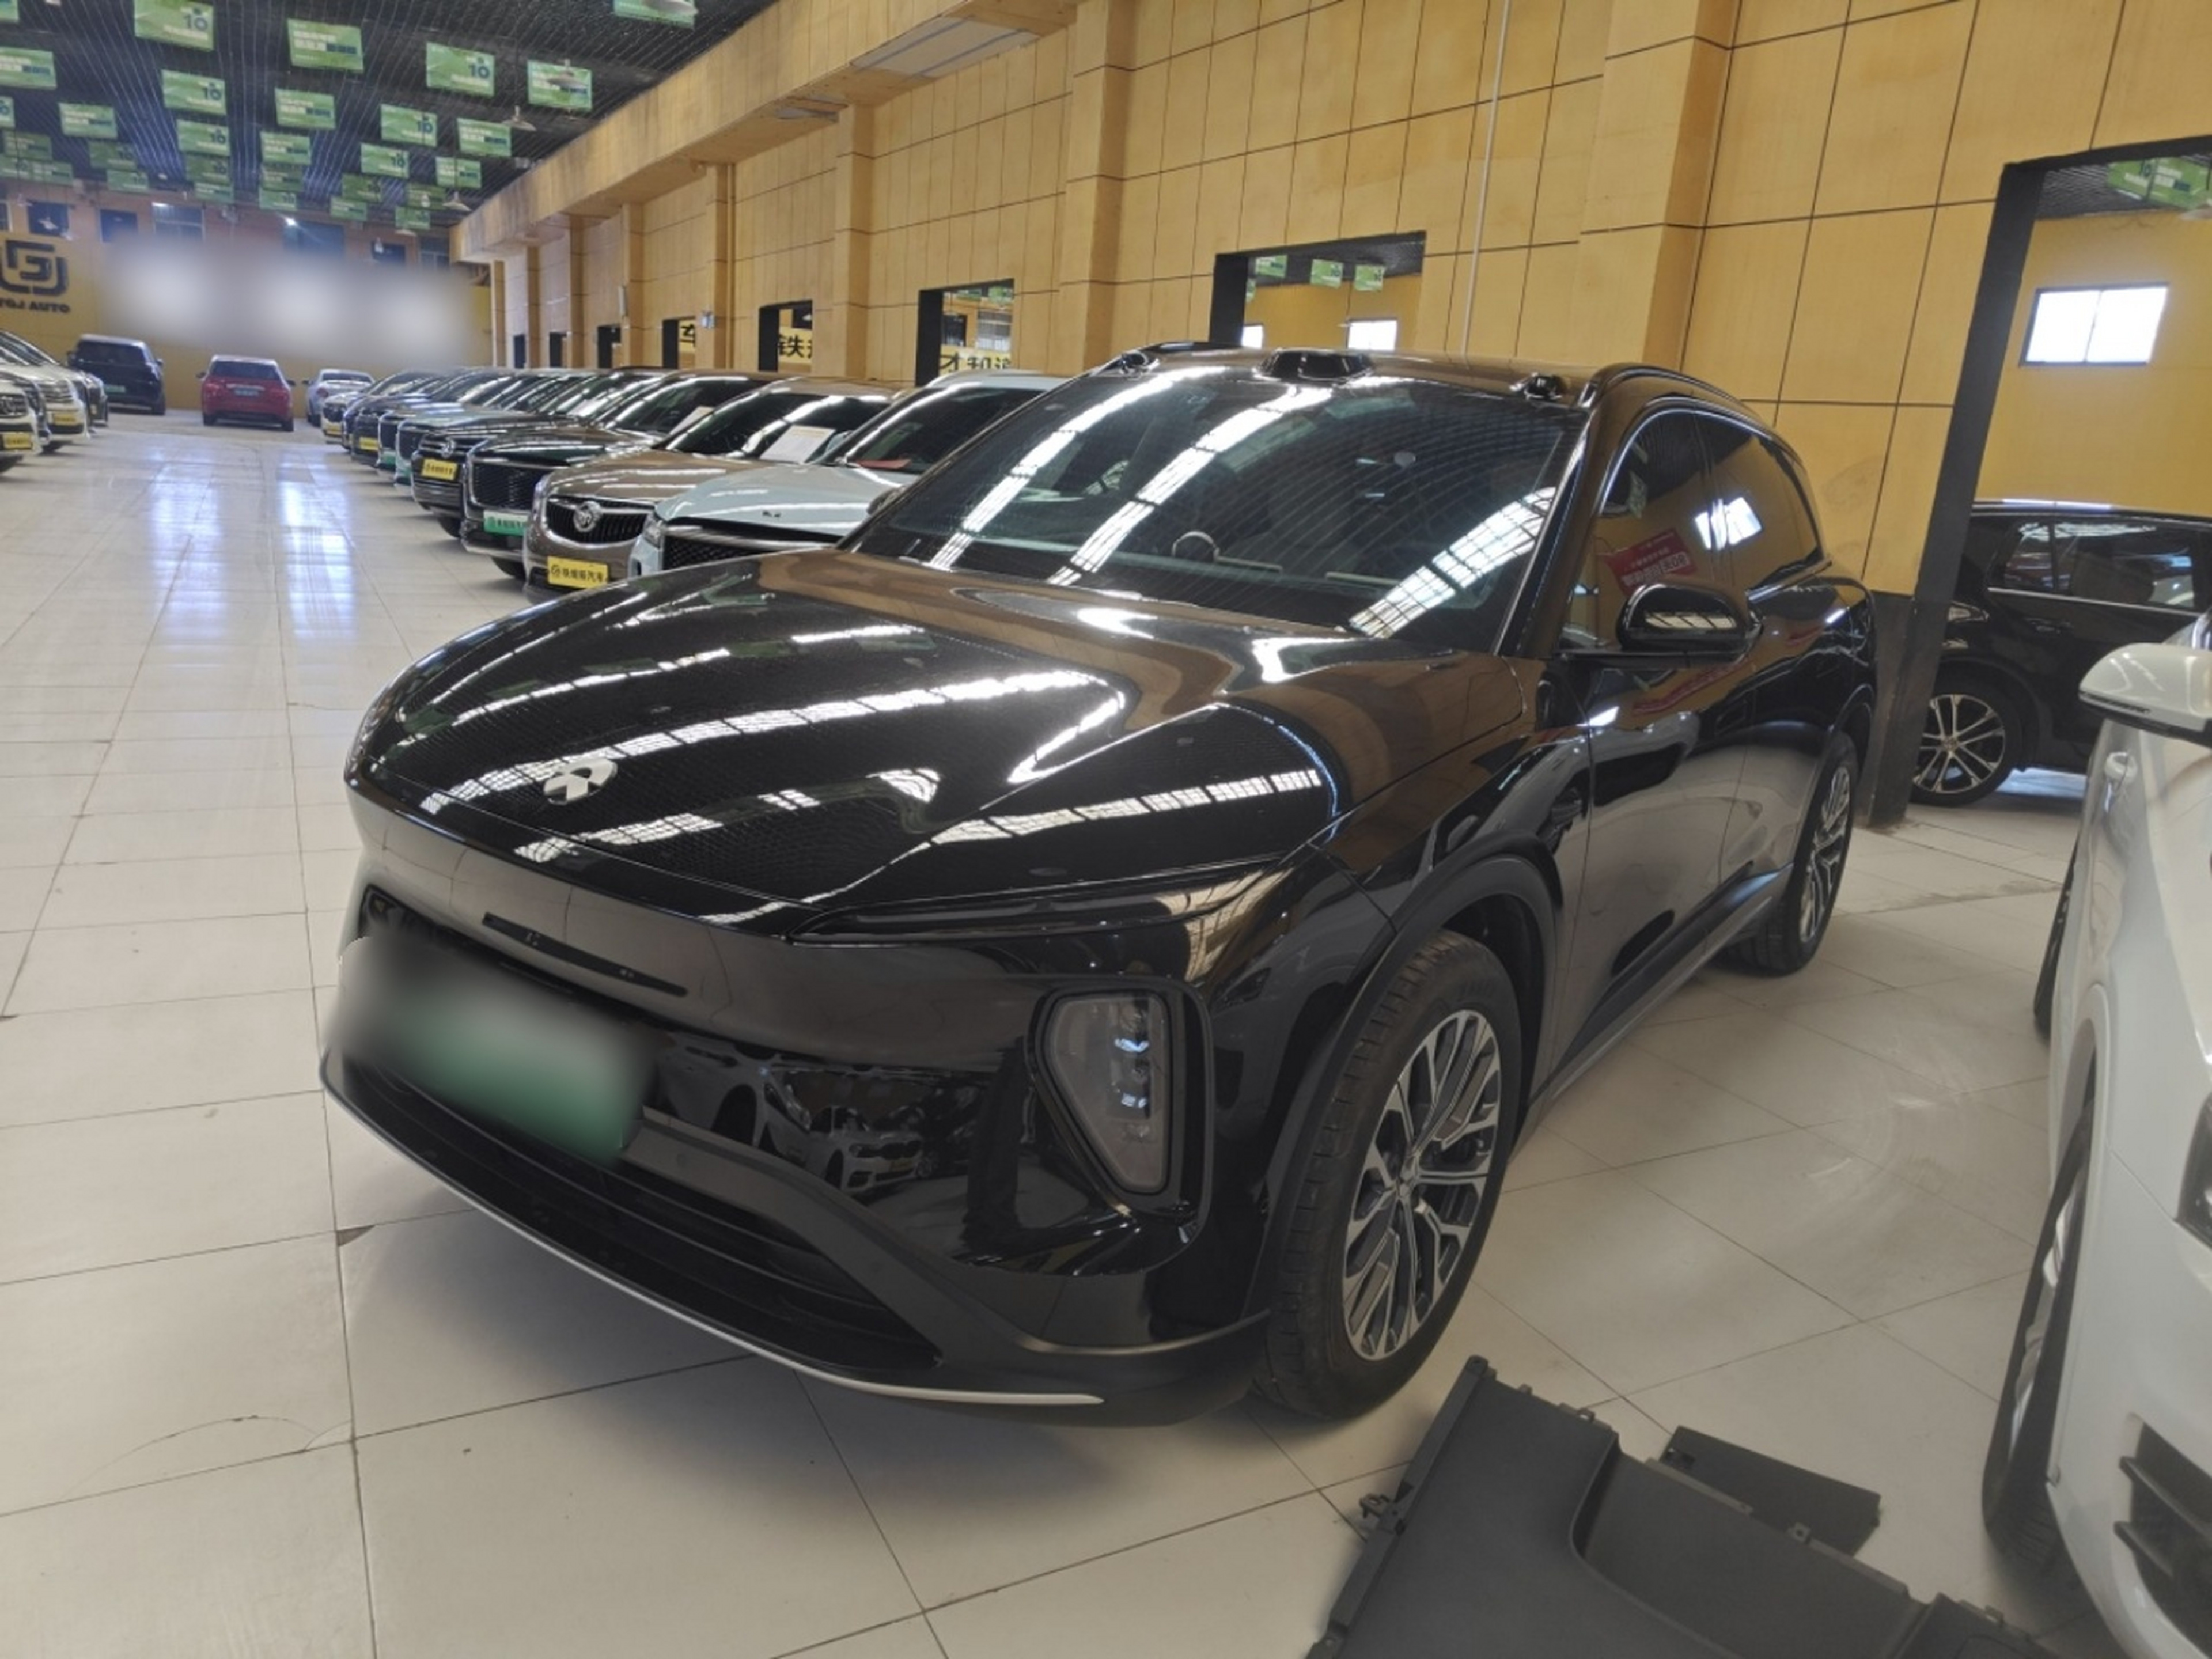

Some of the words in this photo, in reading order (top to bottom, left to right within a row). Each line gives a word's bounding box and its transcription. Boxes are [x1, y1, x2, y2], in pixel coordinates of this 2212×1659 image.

[184, 14, 208, 31] 10
[469, 63, 490, 79] 10
[202, 87, 222, 101] 10
[29, 301, 70, 314] AUTO
